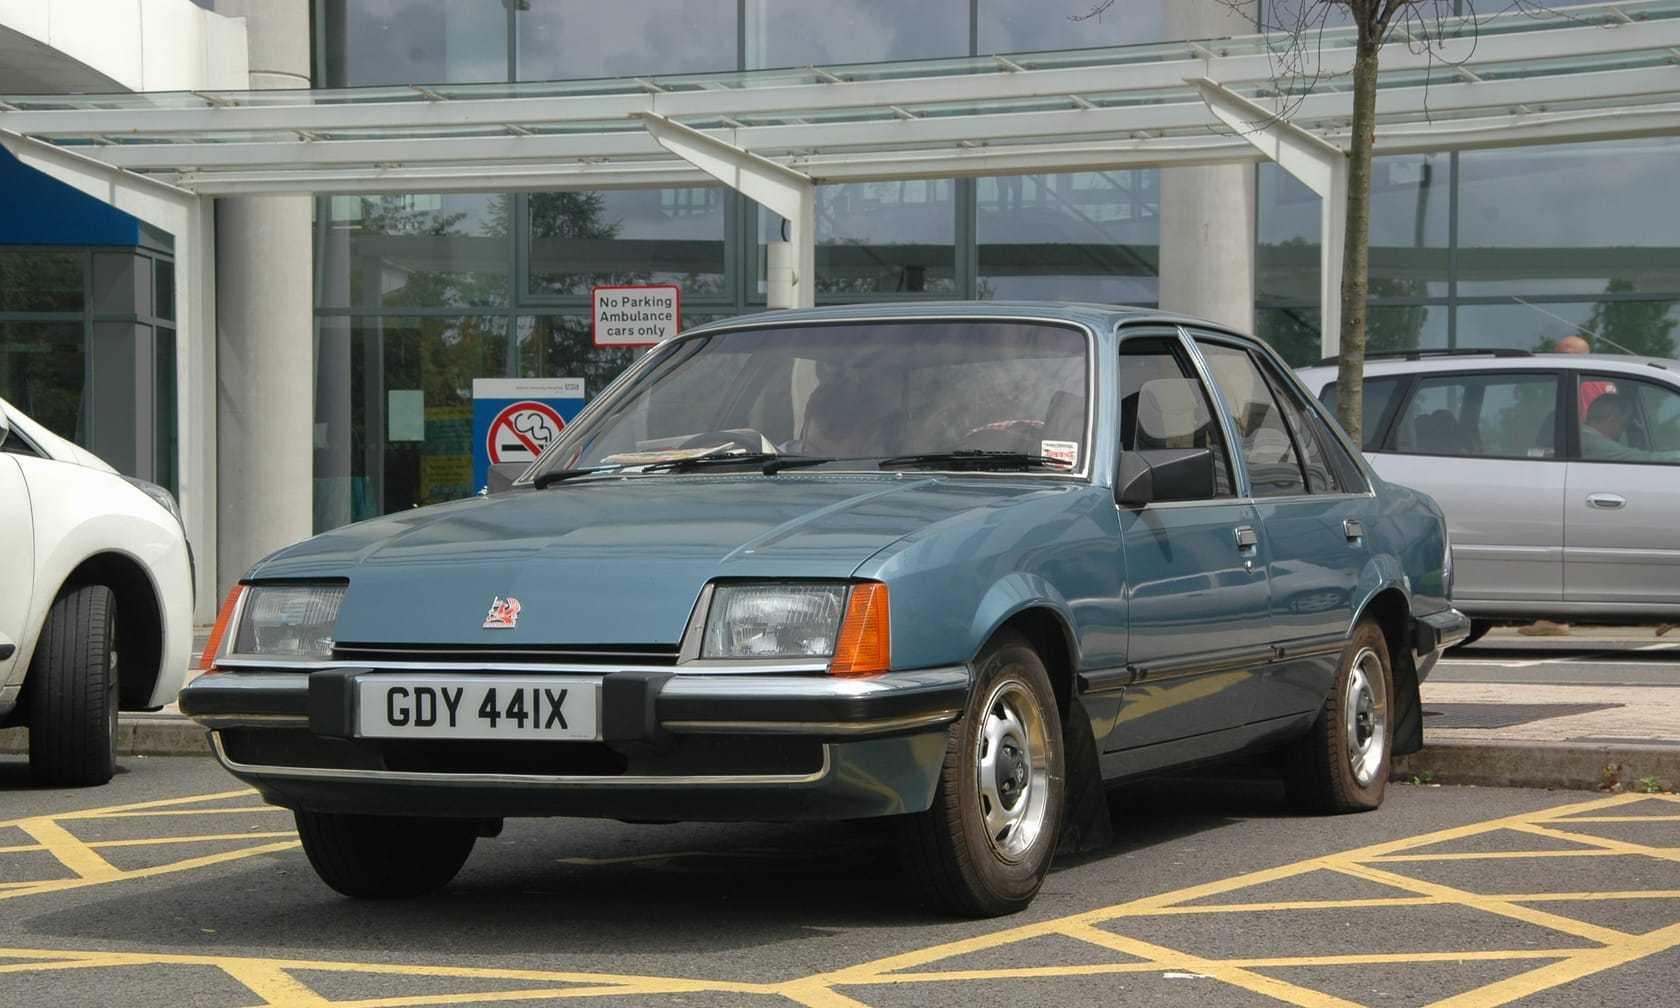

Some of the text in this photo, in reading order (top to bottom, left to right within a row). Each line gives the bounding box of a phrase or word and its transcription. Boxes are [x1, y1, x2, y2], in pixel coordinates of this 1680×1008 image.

[600, 296, 672, 308] No Parking
[600, 311, 672, 322] Ambulance
[607, 325, 665, 337] cars only
[387, 686, 568, 729] GDY 441X
